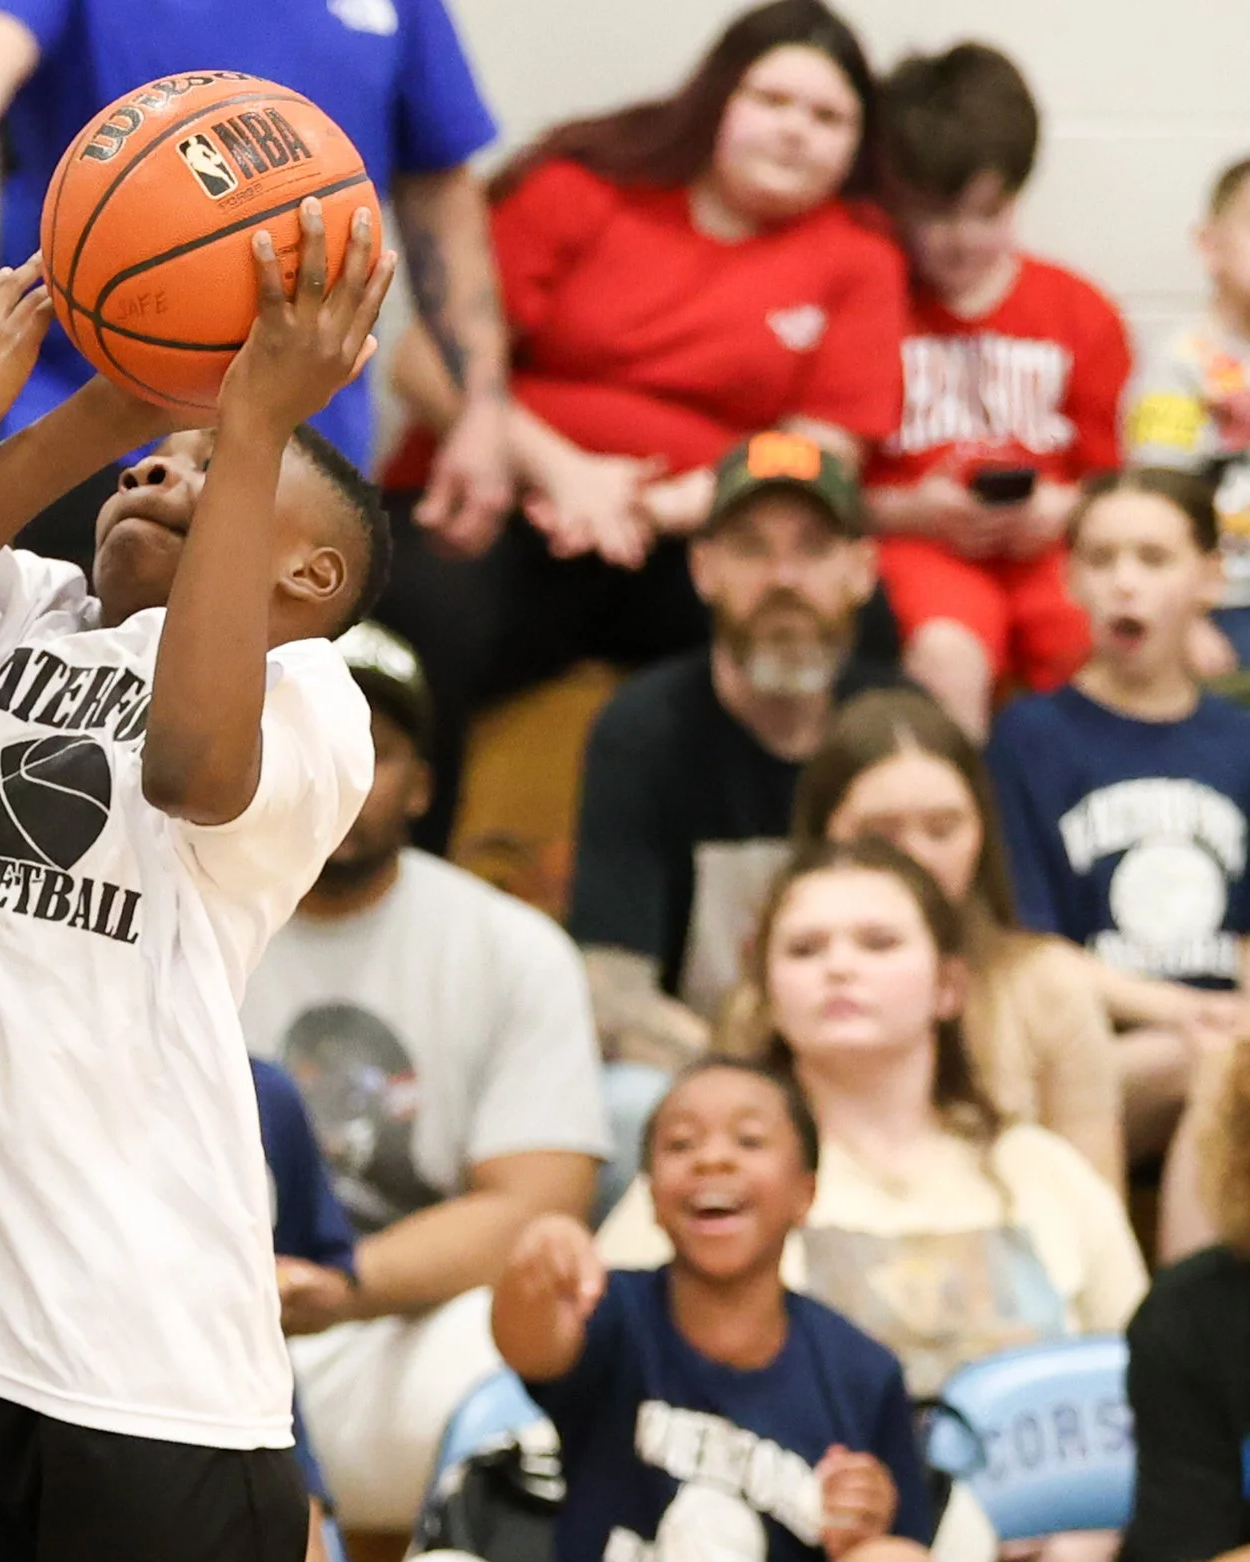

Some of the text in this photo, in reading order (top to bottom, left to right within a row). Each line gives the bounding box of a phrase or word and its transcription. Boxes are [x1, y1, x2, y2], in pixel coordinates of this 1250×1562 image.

[79, 70, 263, 162] Wilso
[210, 107, 312, 180] NBA
[116, 290, 169, 321] SAFE
